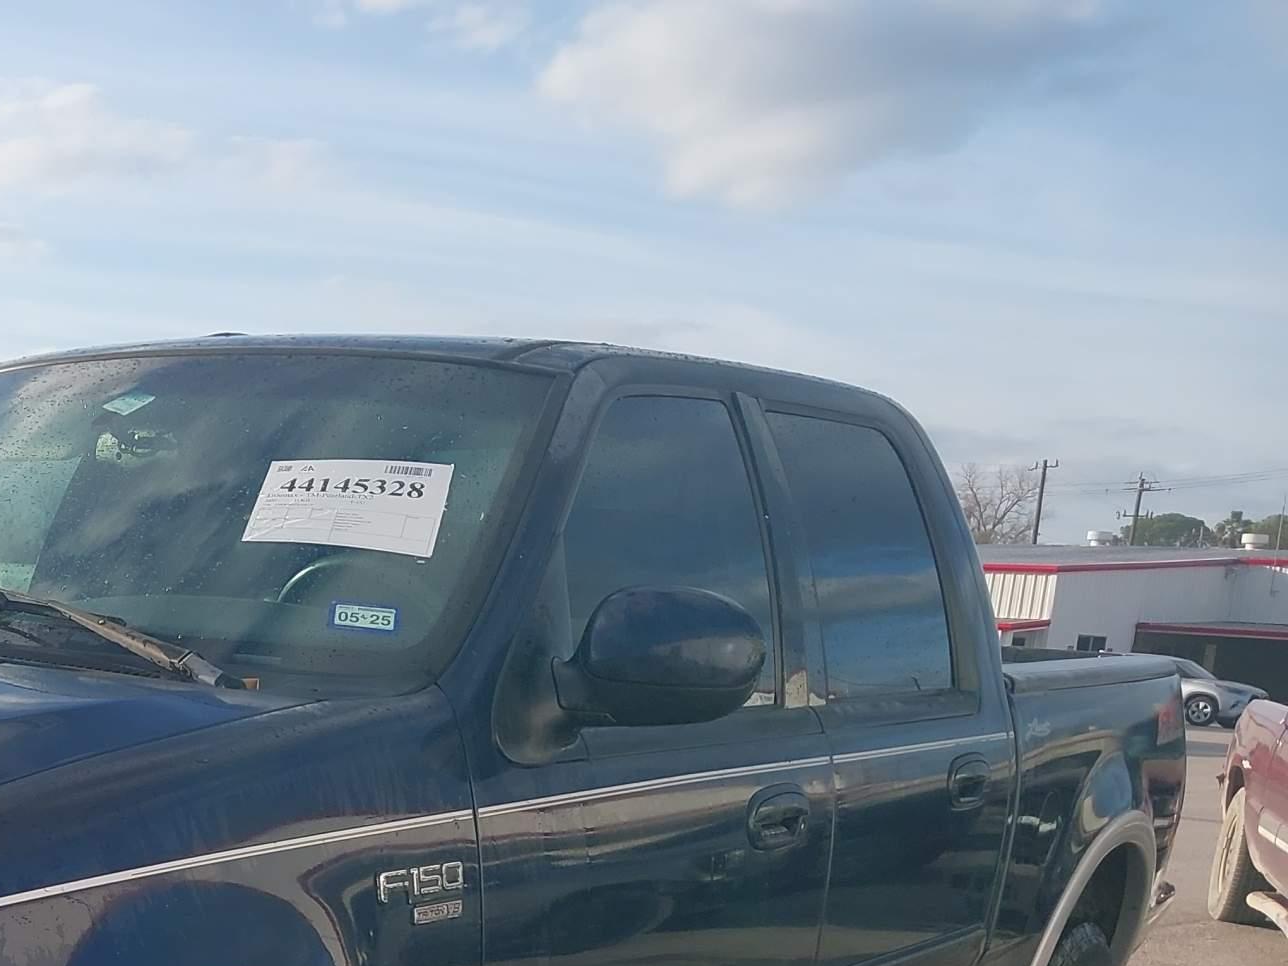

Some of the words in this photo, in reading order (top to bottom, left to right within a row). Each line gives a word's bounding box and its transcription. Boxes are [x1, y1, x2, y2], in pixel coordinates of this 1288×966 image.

[279, 477, 426, 500] 44145328
[337, 611, 360, 623] 05
[369, 614, 392, 626] 25
